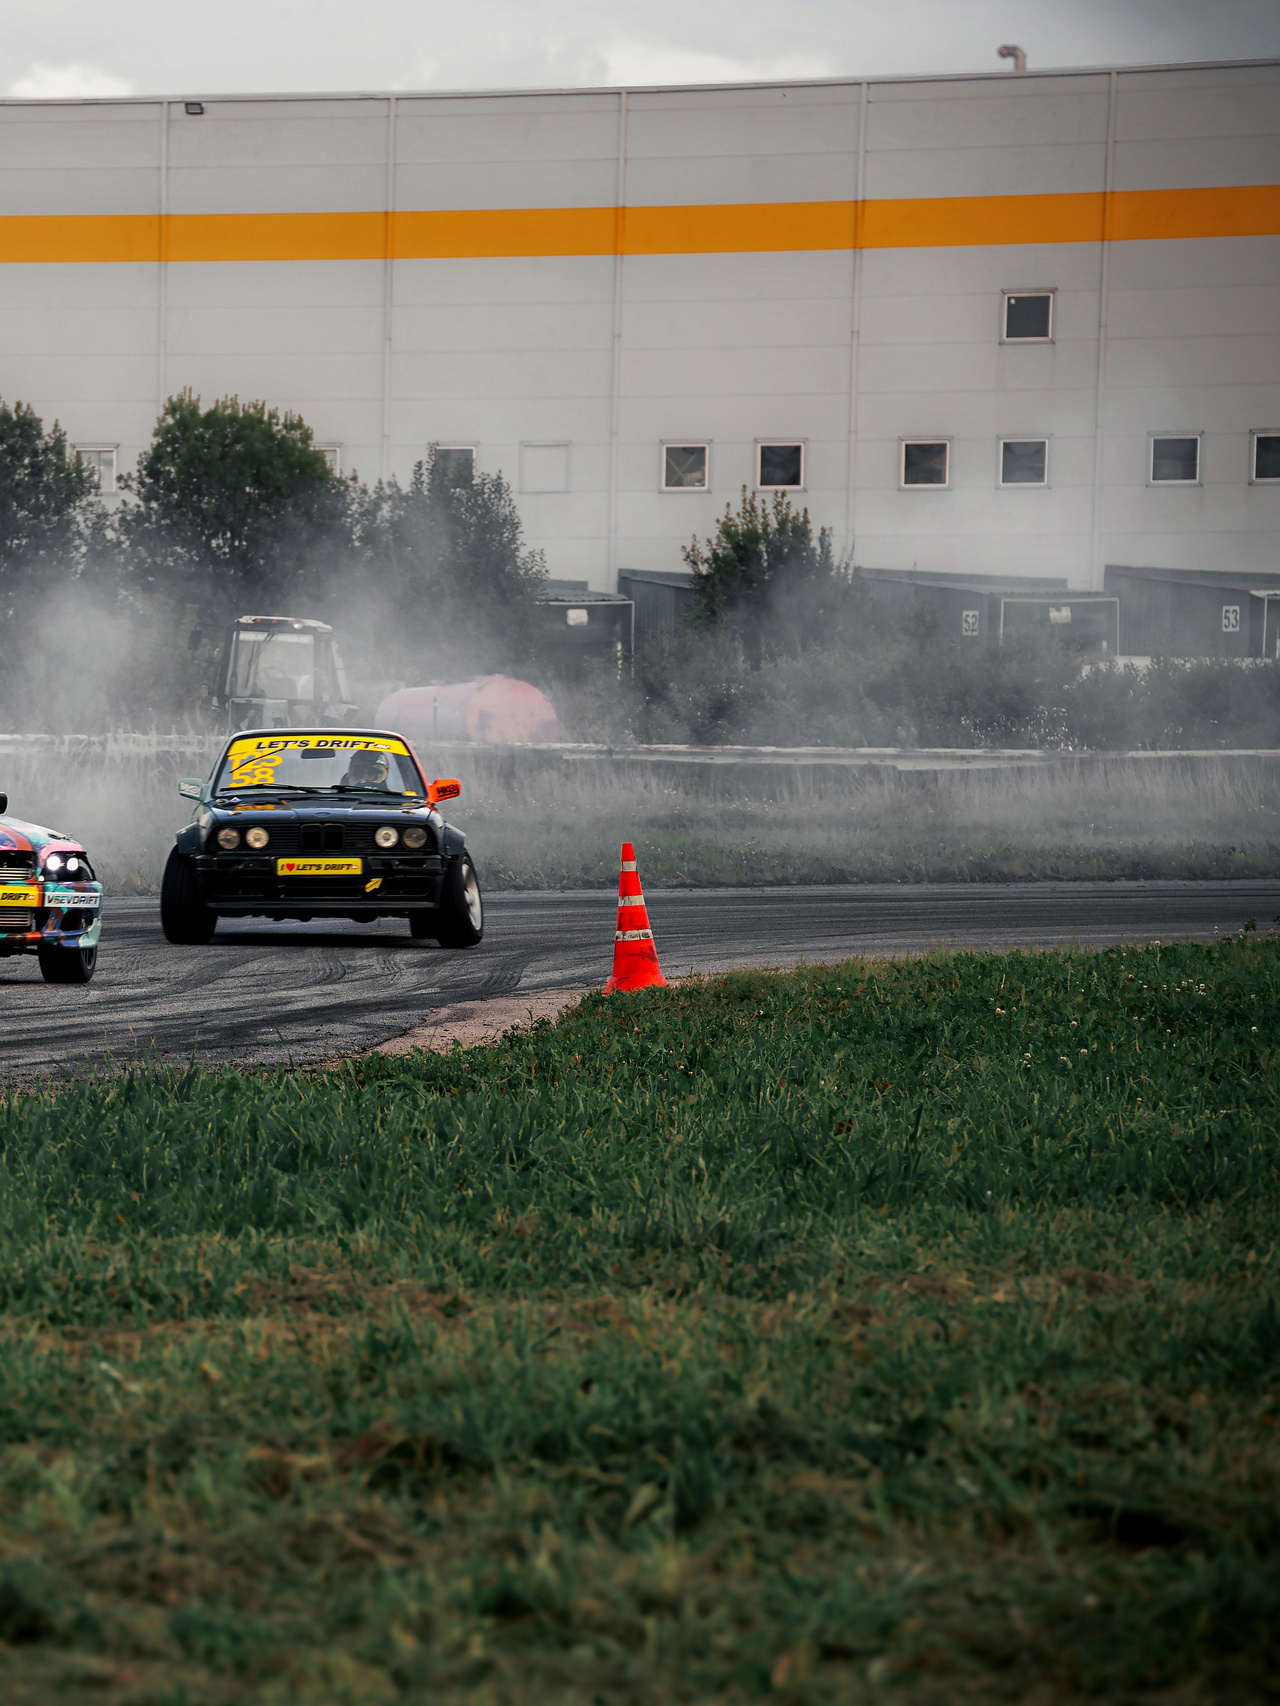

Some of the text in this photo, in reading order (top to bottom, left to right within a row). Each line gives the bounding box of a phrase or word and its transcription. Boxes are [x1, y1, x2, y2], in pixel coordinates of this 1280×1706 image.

[964, 614, 977, 633] 52
[1224, 609, 1238, 629] 53
[256, 740, 311, 749] LET'S
[316, 740, 375, 748] DRIFT
[228, 767, 275, 788] 58
[1, 892, 29, 901] DRIFT
